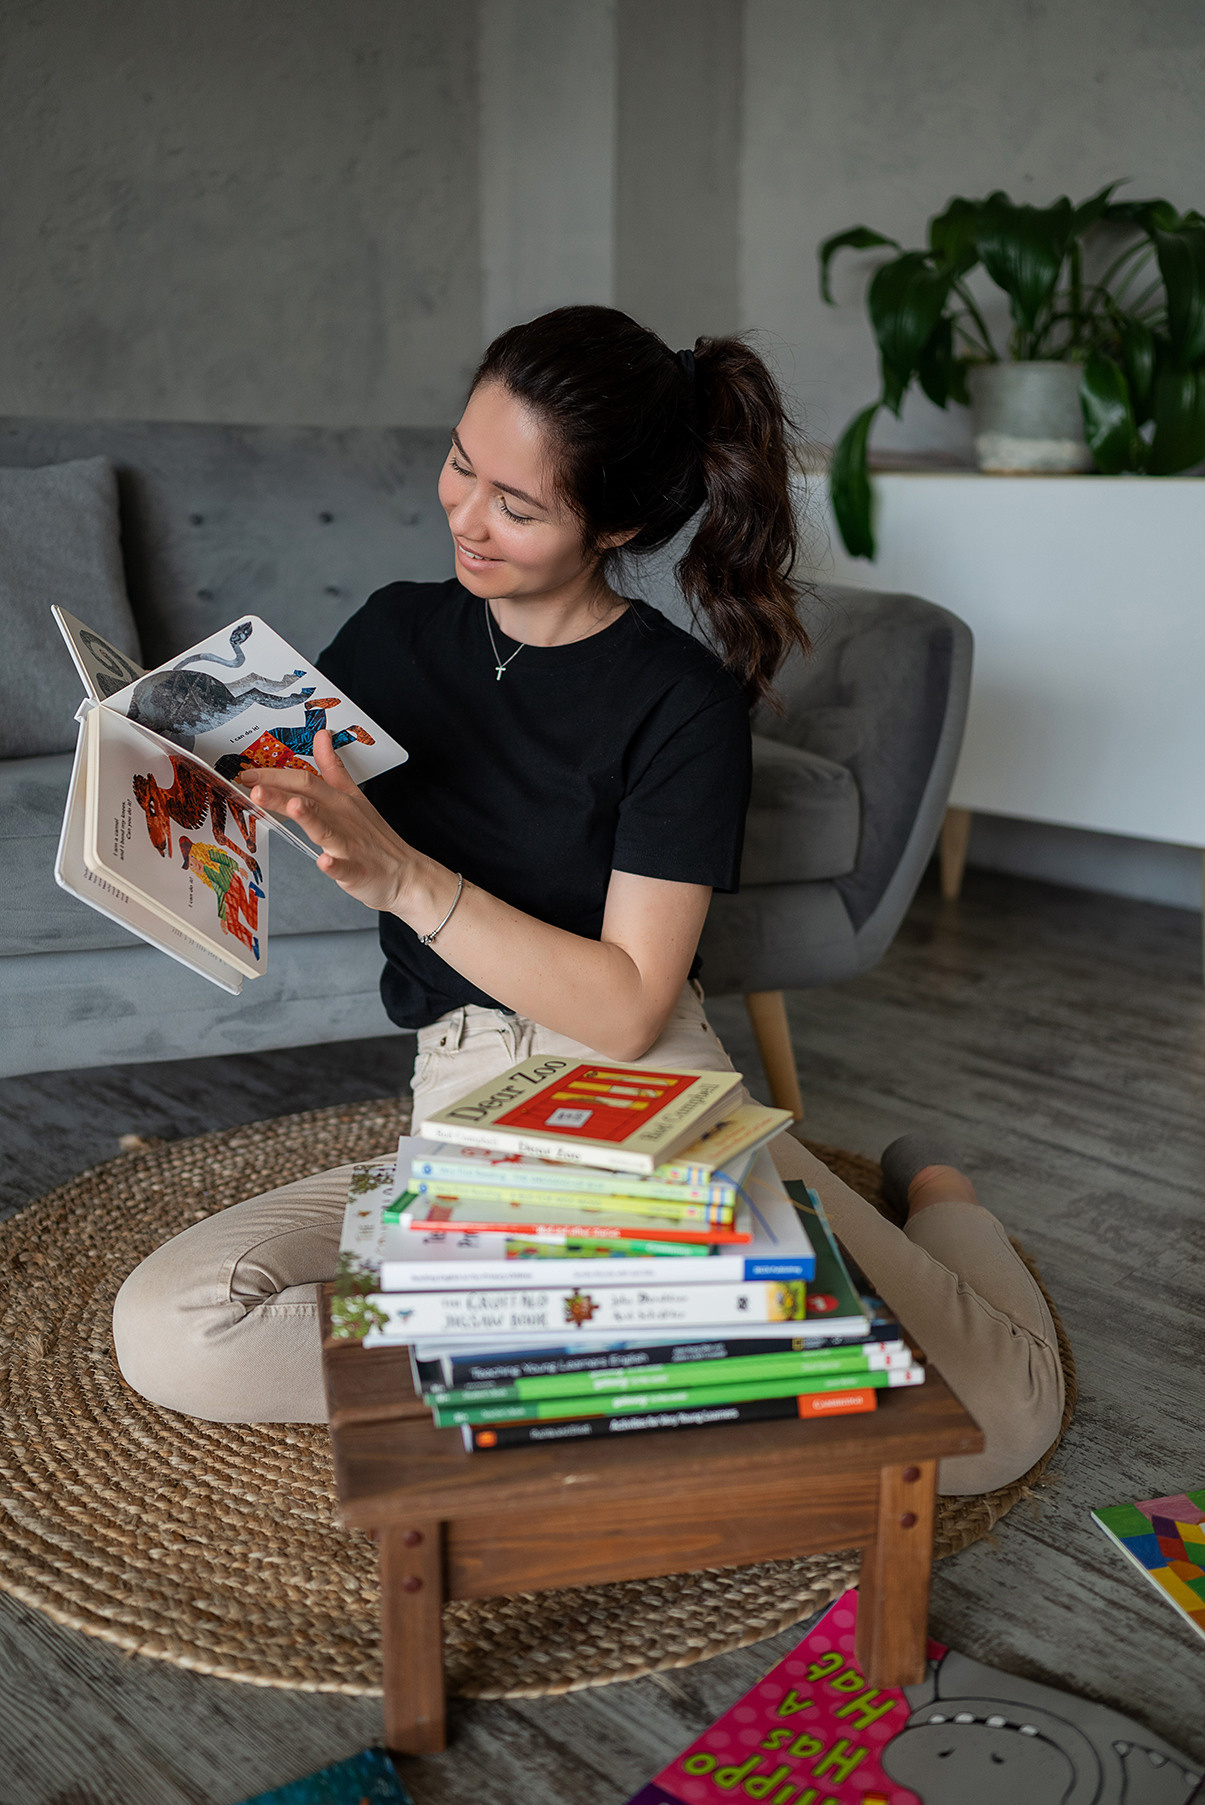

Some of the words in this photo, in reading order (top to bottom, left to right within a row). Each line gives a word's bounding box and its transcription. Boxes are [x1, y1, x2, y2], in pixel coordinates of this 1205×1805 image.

[234, 734, 245, 742] can
[121, 820, 127, 829] my
[127, 808, 132, 816] do
[114, 843, 119, 852] am
[189, 884, 194, 893] do
[446, 1084, 525, 1122] Dear
[508, 1060, 567, 1085] Zoo
[639, 1122, 673, 1142] Rod
[662, 1083, 720, 1123] Campbell
[471, 1364, 523, 1380] Teaching
[522, 1361, 557, 1375] Young
[558, 1356, 608, 1372] Learners
[608, 1352, 650, 1368] English
[776, 1688, 816, 1718] A
[805, 1651, 899, 1731] Hat
[759, 1727, 871, 1785] Has
[683, 1751, 840, 1805] ippo
